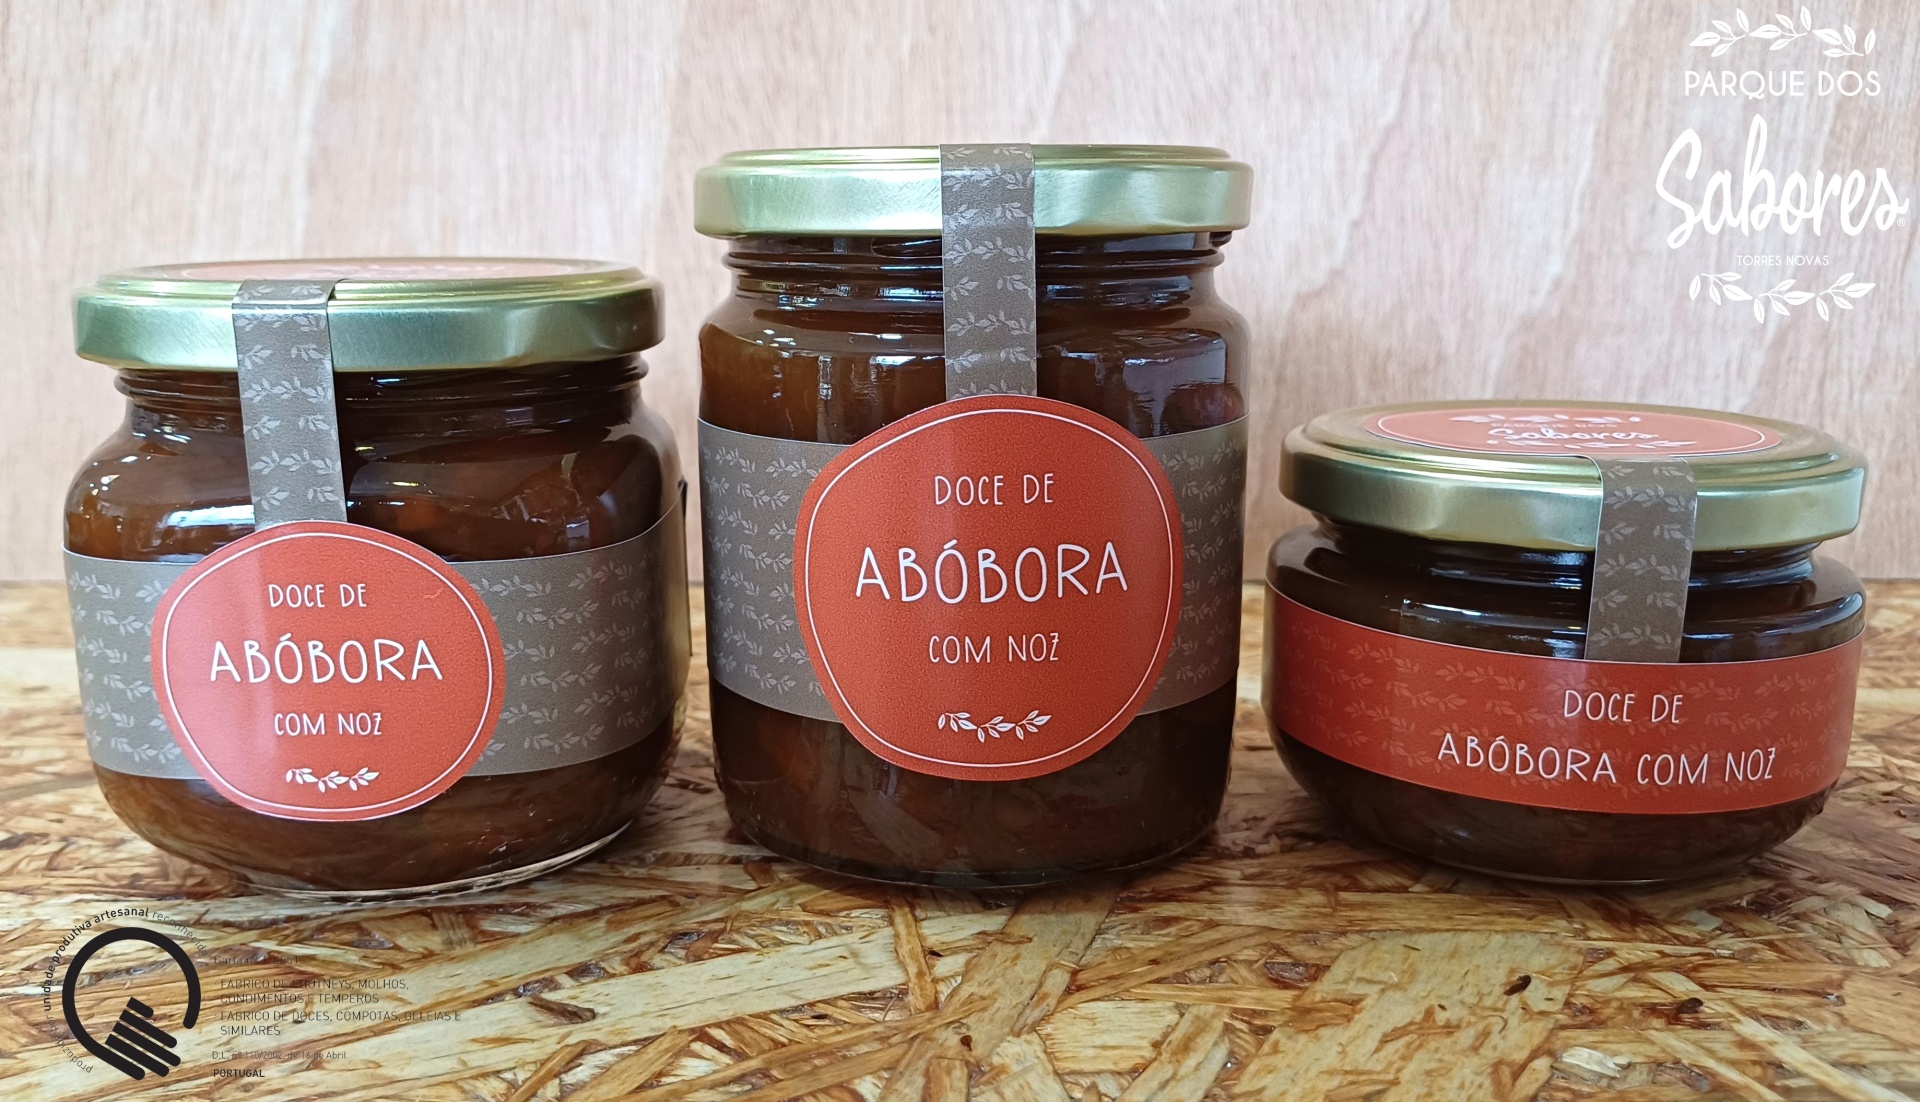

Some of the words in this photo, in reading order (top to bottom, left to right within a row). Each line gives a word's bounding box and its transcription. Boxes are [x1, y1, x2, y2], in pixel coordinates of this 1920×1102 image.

[934, 475, 1004, 505] DOCE
[1023, 473, 1054, 504] DE
[855, 539, 1128, 604] ABÓBORA
[268, 583, 326, 608] DOCE
[339, 583, 368, 608] DE
[210, 632, 443, 684] ABÓBORA
[928, 635, 991, 665] COM
[1008, 632, 1060, 663] NOZ
[1563, 689, 1636, 723] DOCE
[1651, 694, 1684, 724] DE
[274, 713, 326, 737] COM
[338, 712, 383, 736] NOZ
[1437, 732, 1618, 785] ABÓBORA
[1636, 752, 1709, 787] COM
[1724, 747, 1777, 783] NOZ
